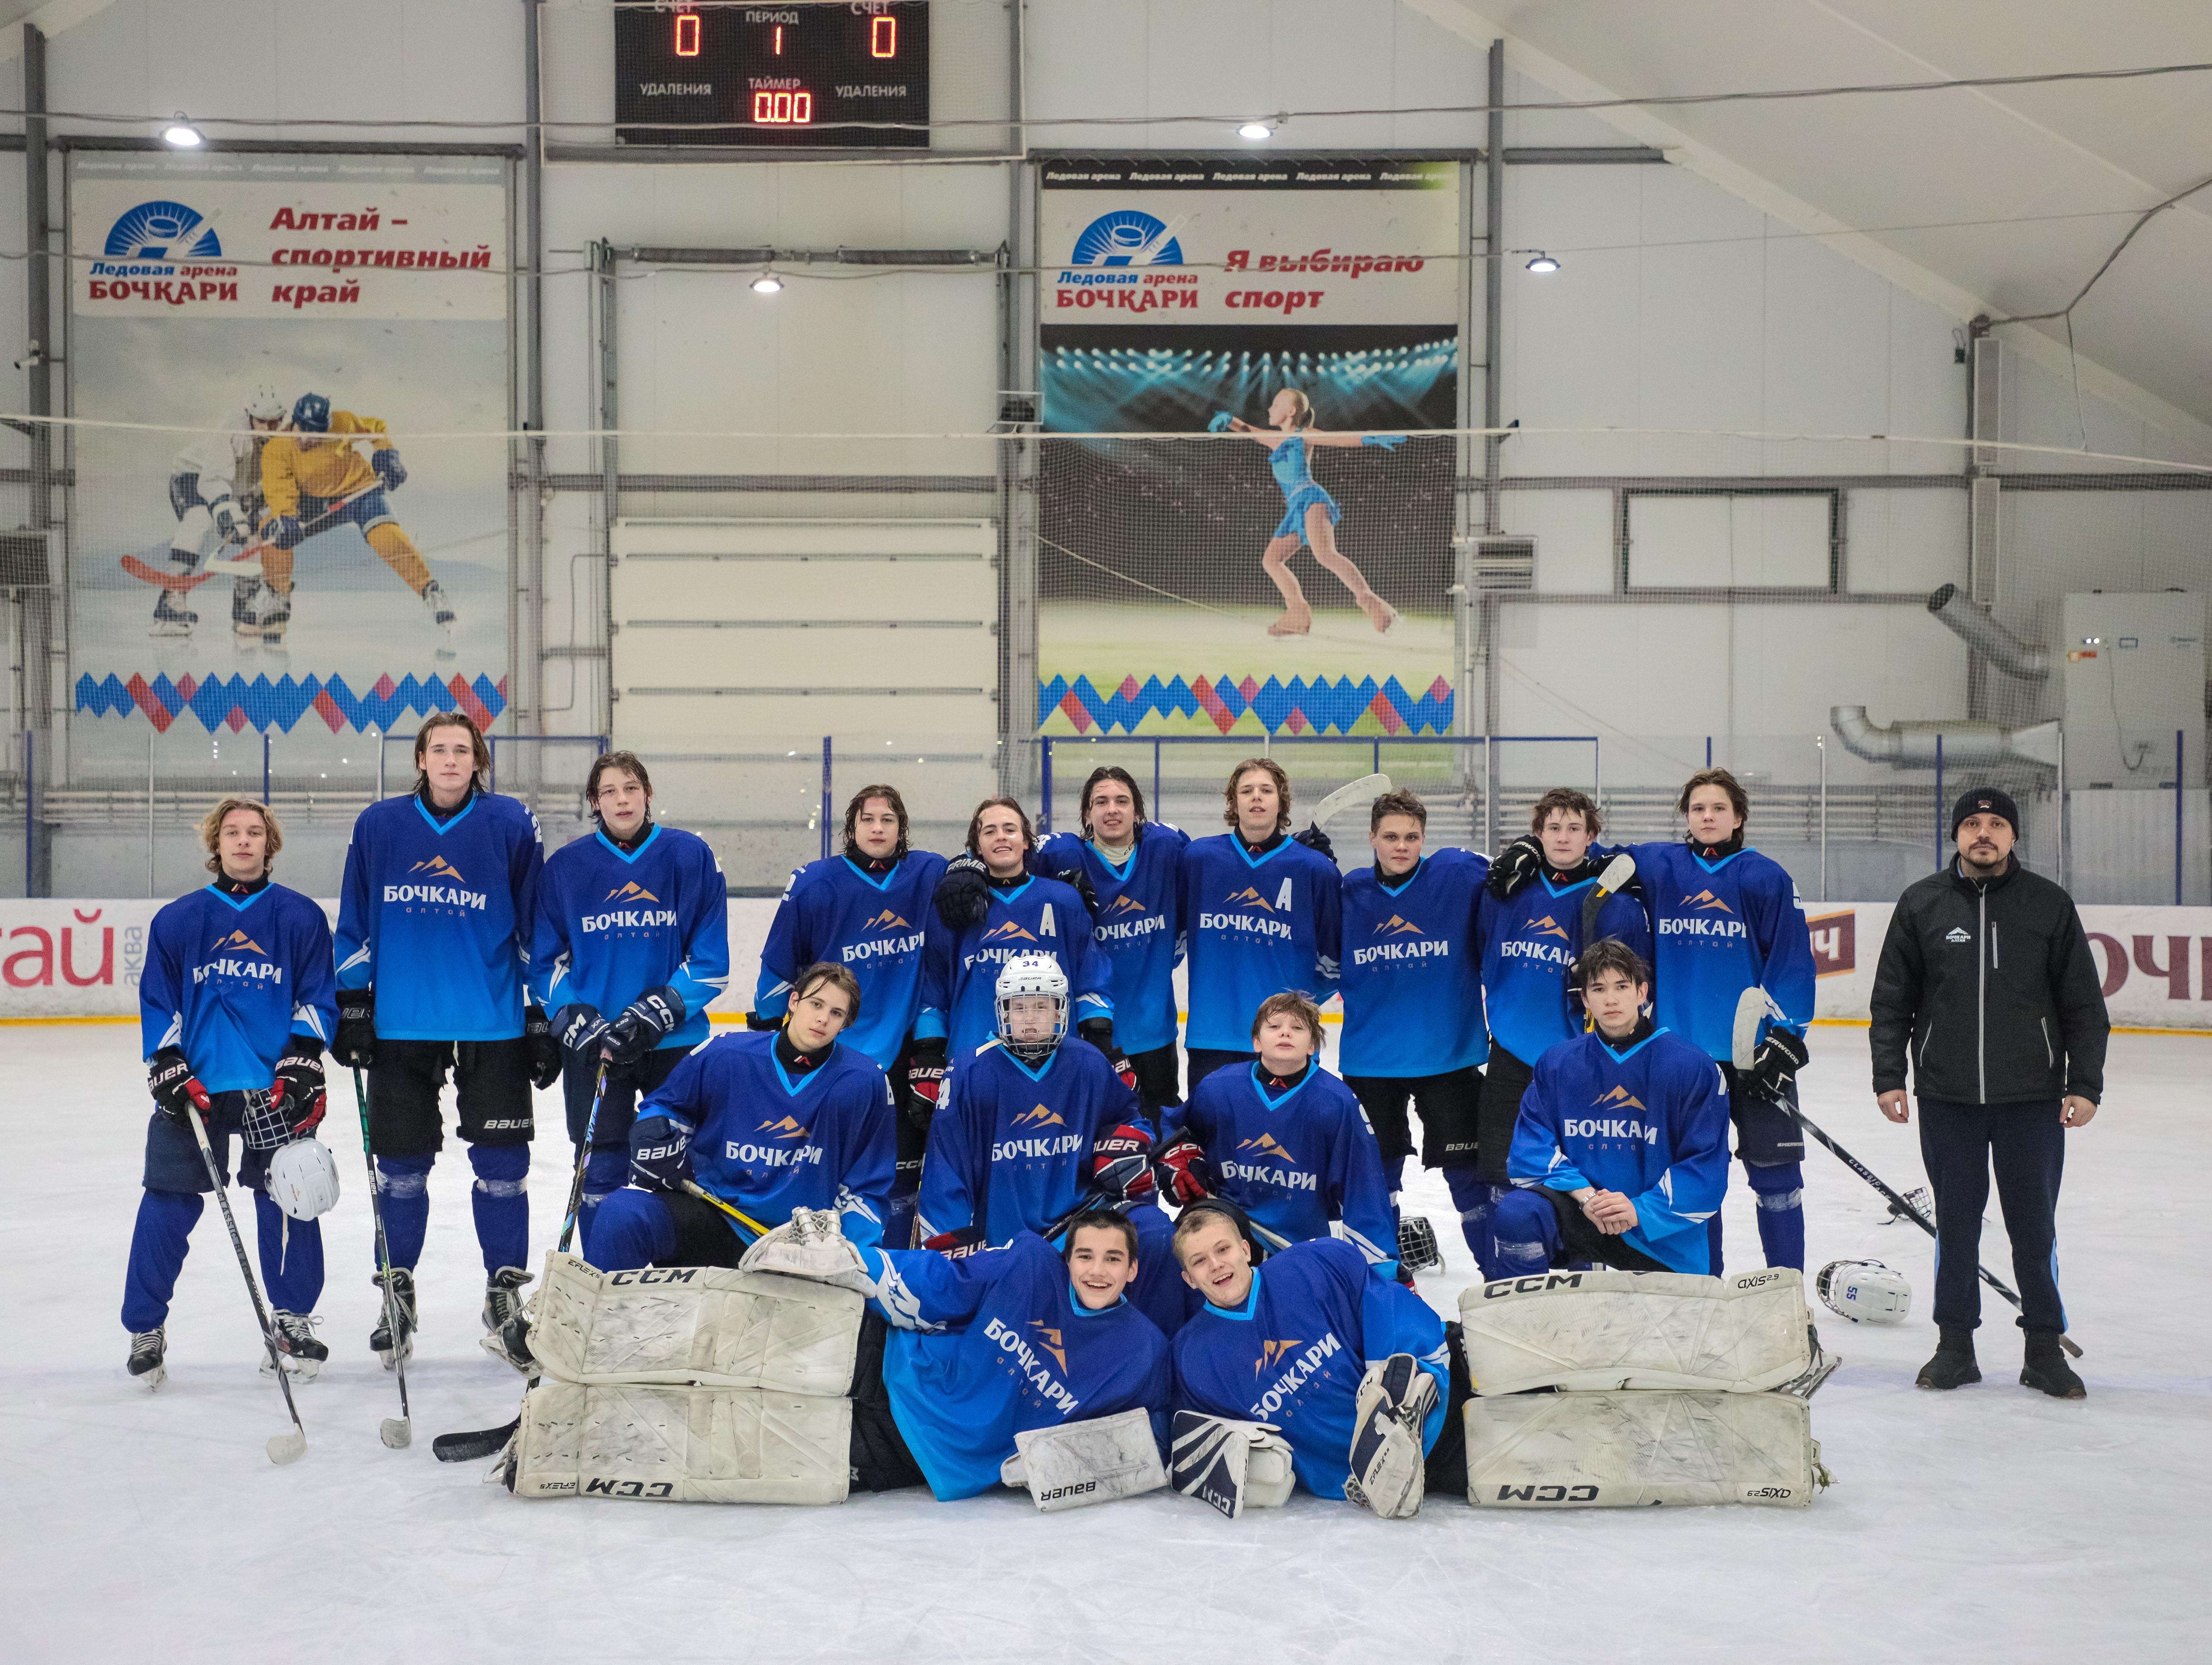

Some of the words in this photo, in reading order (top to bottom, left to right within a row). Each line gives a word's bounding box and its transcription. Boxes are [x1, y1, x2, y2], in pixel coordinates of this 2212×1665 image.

[746, 11, 799, 25] ПЕРИОД
[676, 15, 700, 56] 0
[775, 26, 782, 55] 1
[871, 17, 896, 57] 0
[640, 84, 711, 96] УДАЛЕНИЯ
[748, 76, 801, 89] ТАЙМЕР
[836, 85, 906, 97] УДАЛЕНИЯ
[269, 207, 380, 231] Алтай
[90, 262, 175, 278] Ледовая
[179, 265, 238, 279] арена
[271, 245, 491, 273] спортивный
[1224, 250, 1250, 272] Я
[1258, 249, 1425, 279] выбираю
[1057, 271, 1138, 285] Ледовая
[1142, 272, 1199, 286] арена
[89, 281, 238, 304] БОЧКАРИ
[271, 280, 360, 308] край
[1056, 290, 1199, 313] БОЧКАРИ
[1225, 290, 1324, 314] спорт
[384, 885, 486, 910] БОЧКАРИ
[582, 911, 677, 932] БОЧКАРИ
[1091, 915, 1165, 941] ОЧКАРИ
[1200, 914, 1292, 940] БОЧКАРИ
[0, 909, 114, 988] ай
[124, 927, 142, 986] аква
[1354, 940, 1448, 965] БОЧКАРИ
[1564, 1119, 1658, 1145] БОЧКАИ
[1164, 1143, 1204, 1160] CC
[1221, 1160, 1317, 1191] БЧКАРИ
[611, 1269, 698, 1286] CCM
[1484, 1274, 1583, 1299] CCM
[983, 1317, 1079, 1415] БОЧКАРИ
[1250, 1332, 1342, 1422] БОЧКАРИ
[585, 1478, 673, 1497] CCM
[1041, 1481, 1096, 1501] BAUER
[1497, 1485, 1599, 1501] CCM
